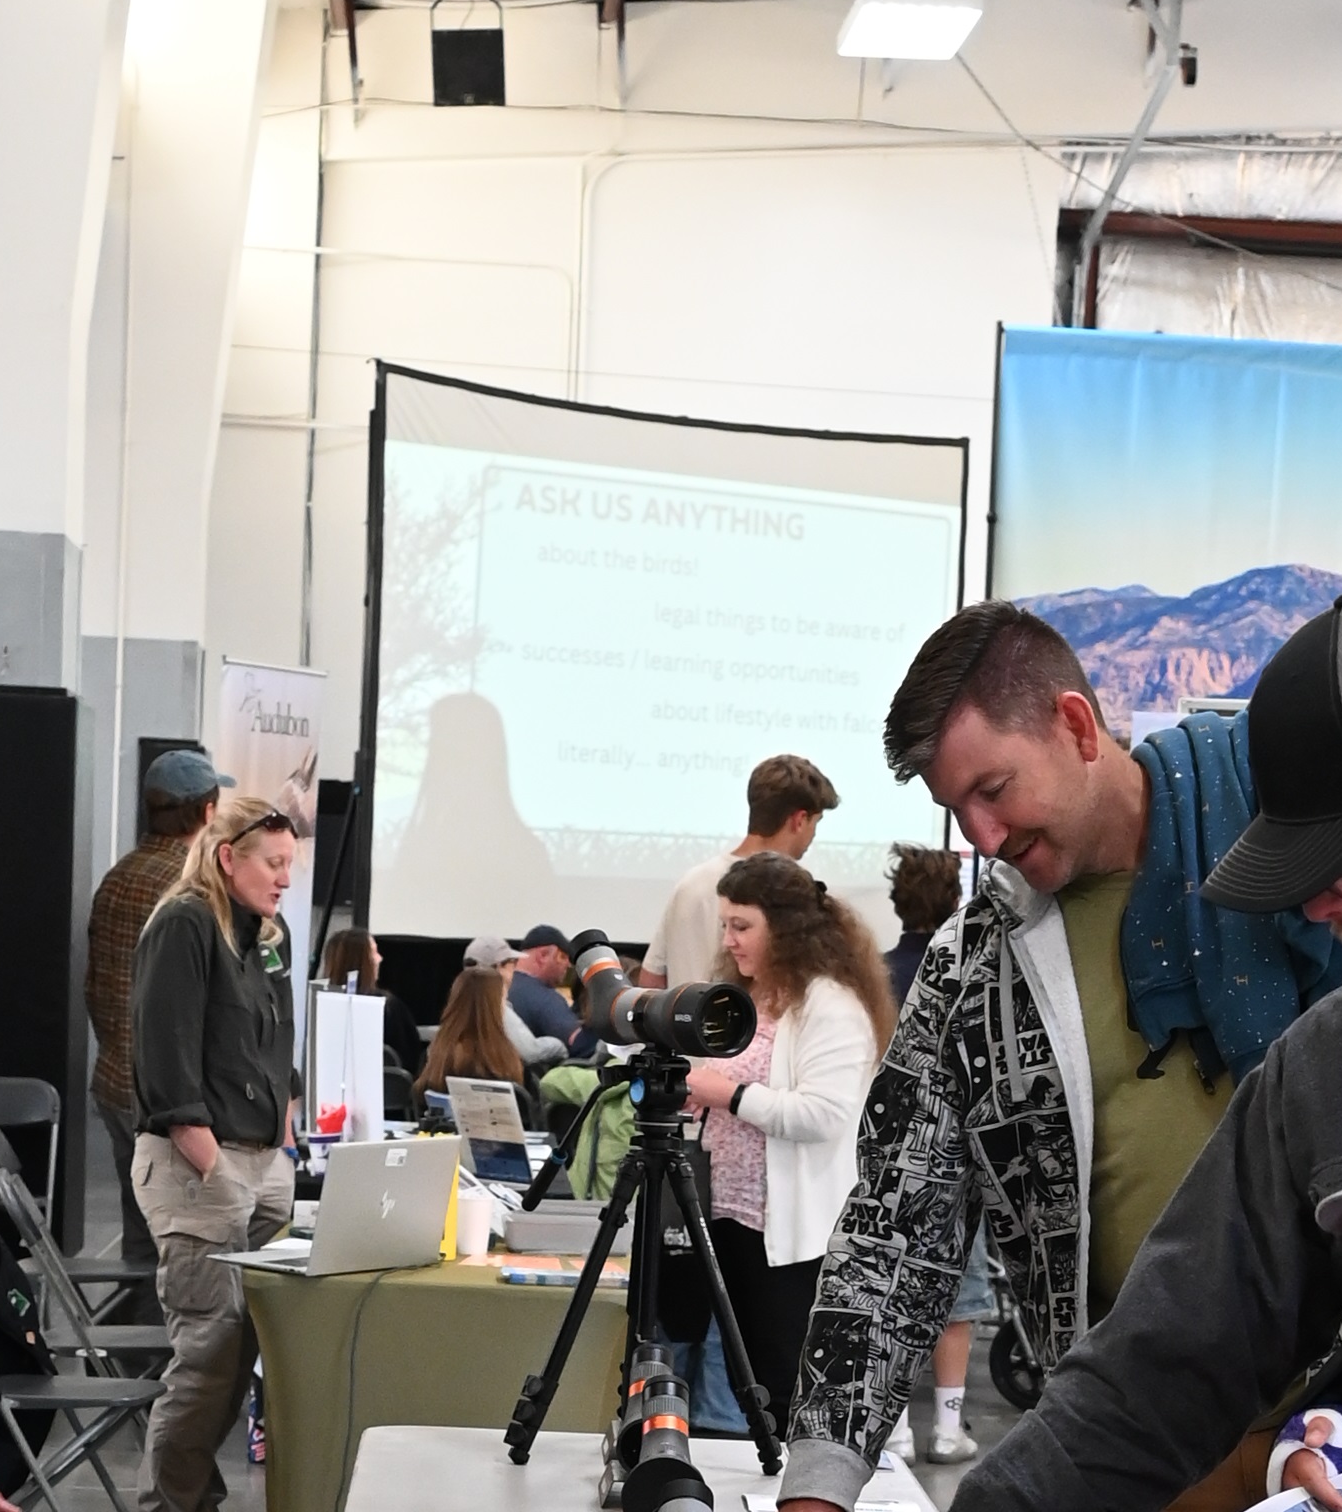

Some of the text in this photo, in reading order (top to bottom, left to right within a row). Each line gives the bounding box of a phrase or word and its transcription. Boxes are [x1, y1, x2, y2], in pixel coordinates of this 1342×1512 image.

[515, 483, 806, 541] ASK US ANYTHING
[537, 543, 699, 576] about the birds!
[654, 601, 906, 643] legal things to be aware of
[520, 641, 625, 669] successes
[644, 650, 724, 681] learning
[729, 659, 860, 687] opportunities
[251, 700, 309, 737] Audubon
[650, 699, 708, 723] about
[714, 702, 792, 732] lifestyle
[796, 708, 838, 732] with
